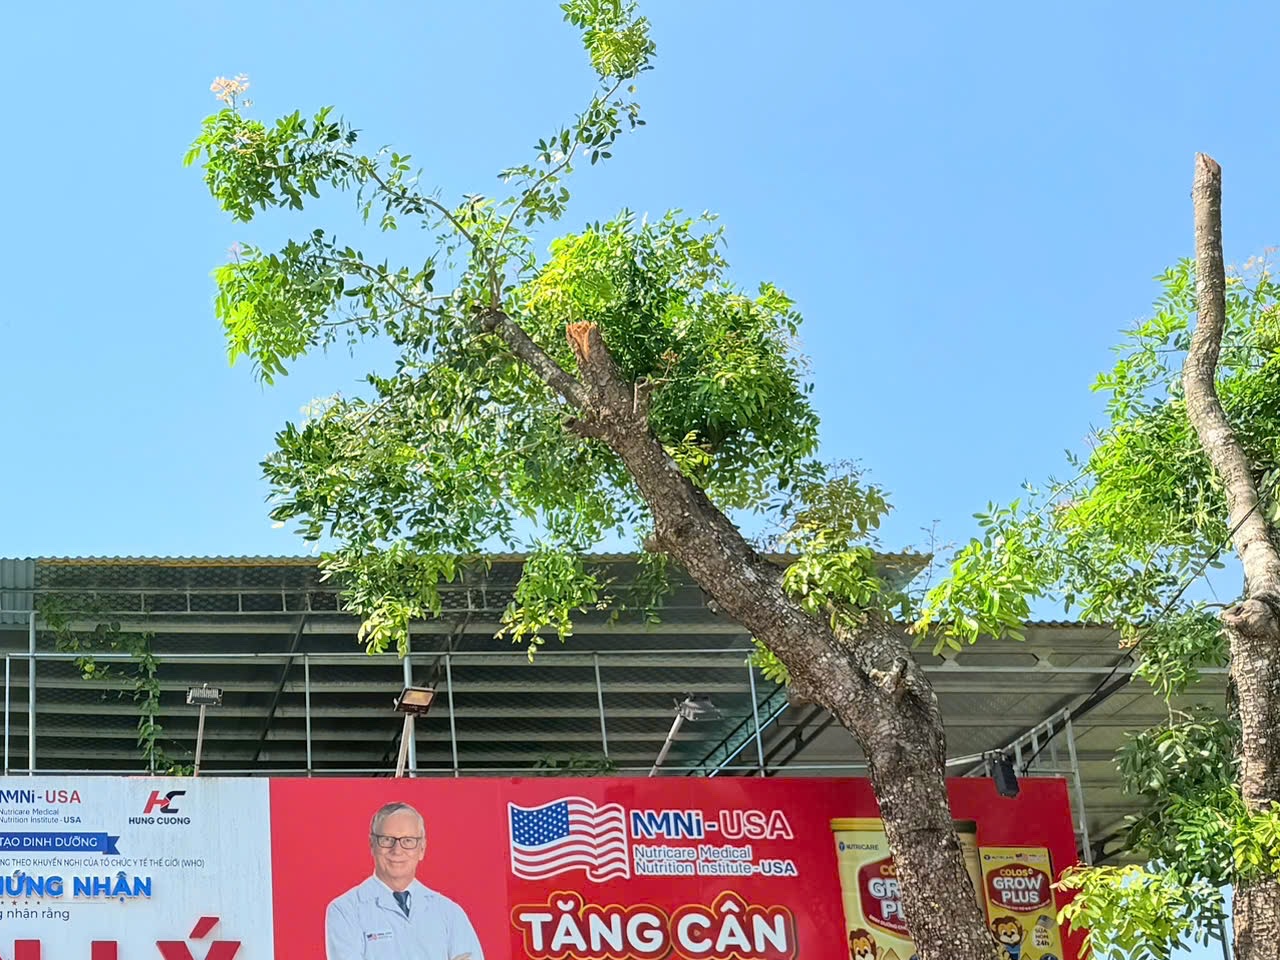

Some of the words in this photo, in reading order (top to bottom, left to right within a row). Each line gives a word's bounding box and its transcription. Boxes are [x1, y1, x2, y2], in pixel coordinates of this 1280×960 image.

[129, 817, 155, 825] HUNG
[157, 817, 190, 825] CUONG
[23, 838, 52, 848] DINH
[54, 836, 98, 848] DƯỠNG
[73, 872, 152, 902] NHẬN
[7, 908, 37, 921] nhận
[42, 907, 70, 921] rằng
[519, 900, 663, 953] TĂNG
[676, 901, 787, 953] CÂN
